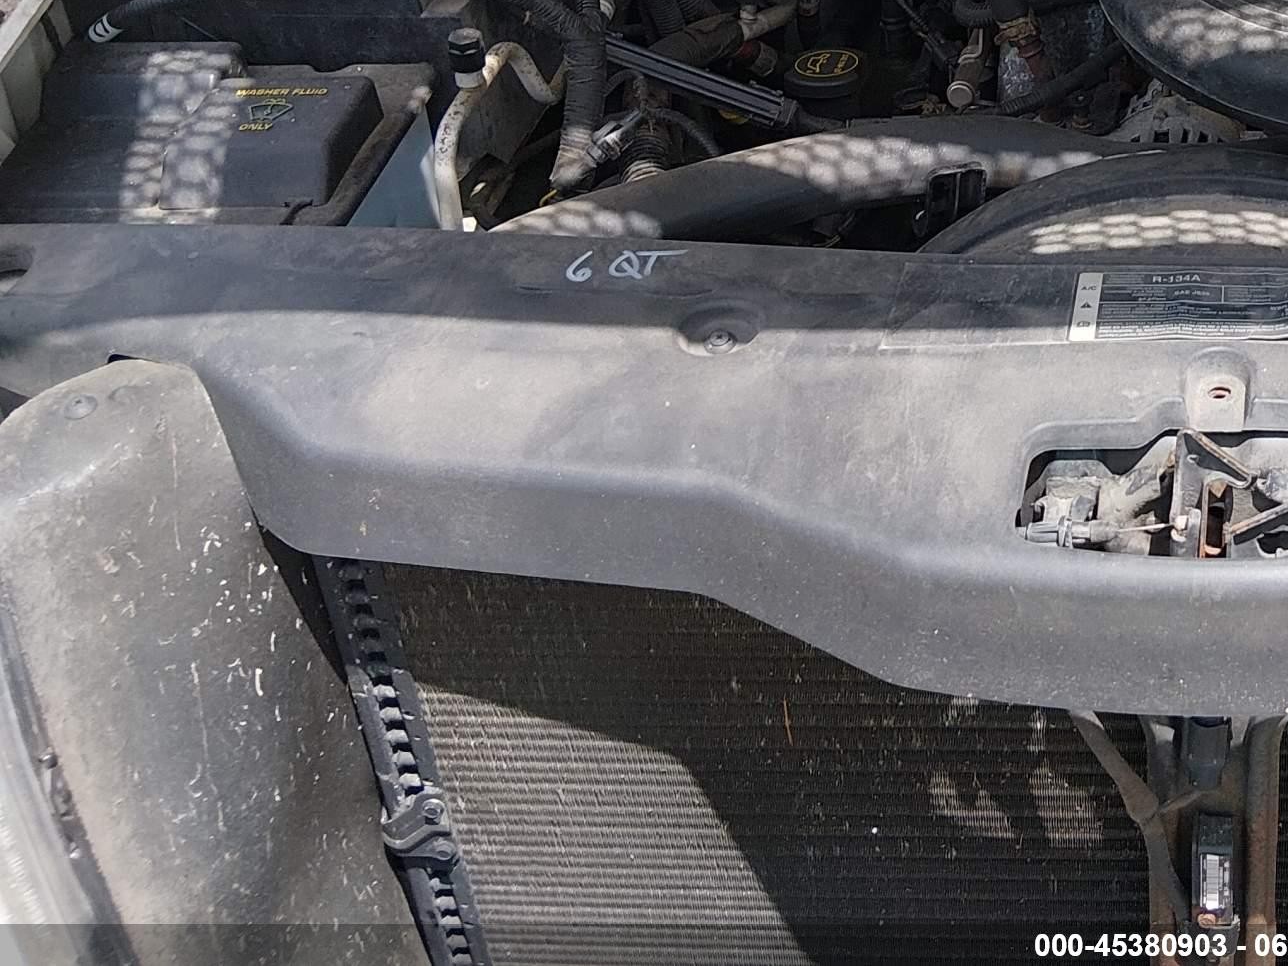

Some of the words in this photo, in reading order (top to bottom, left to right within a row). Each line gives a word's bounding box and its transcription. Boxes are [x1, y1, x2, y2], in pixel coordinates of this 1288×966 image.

[291, 87, 328, 96] FLUID
[238, 122, 273, 131] ONLY
[565, 250, 593, 283] 6
[608, 249, 689, 280] QT
[1152, 273, 1201, 284] R-134A
